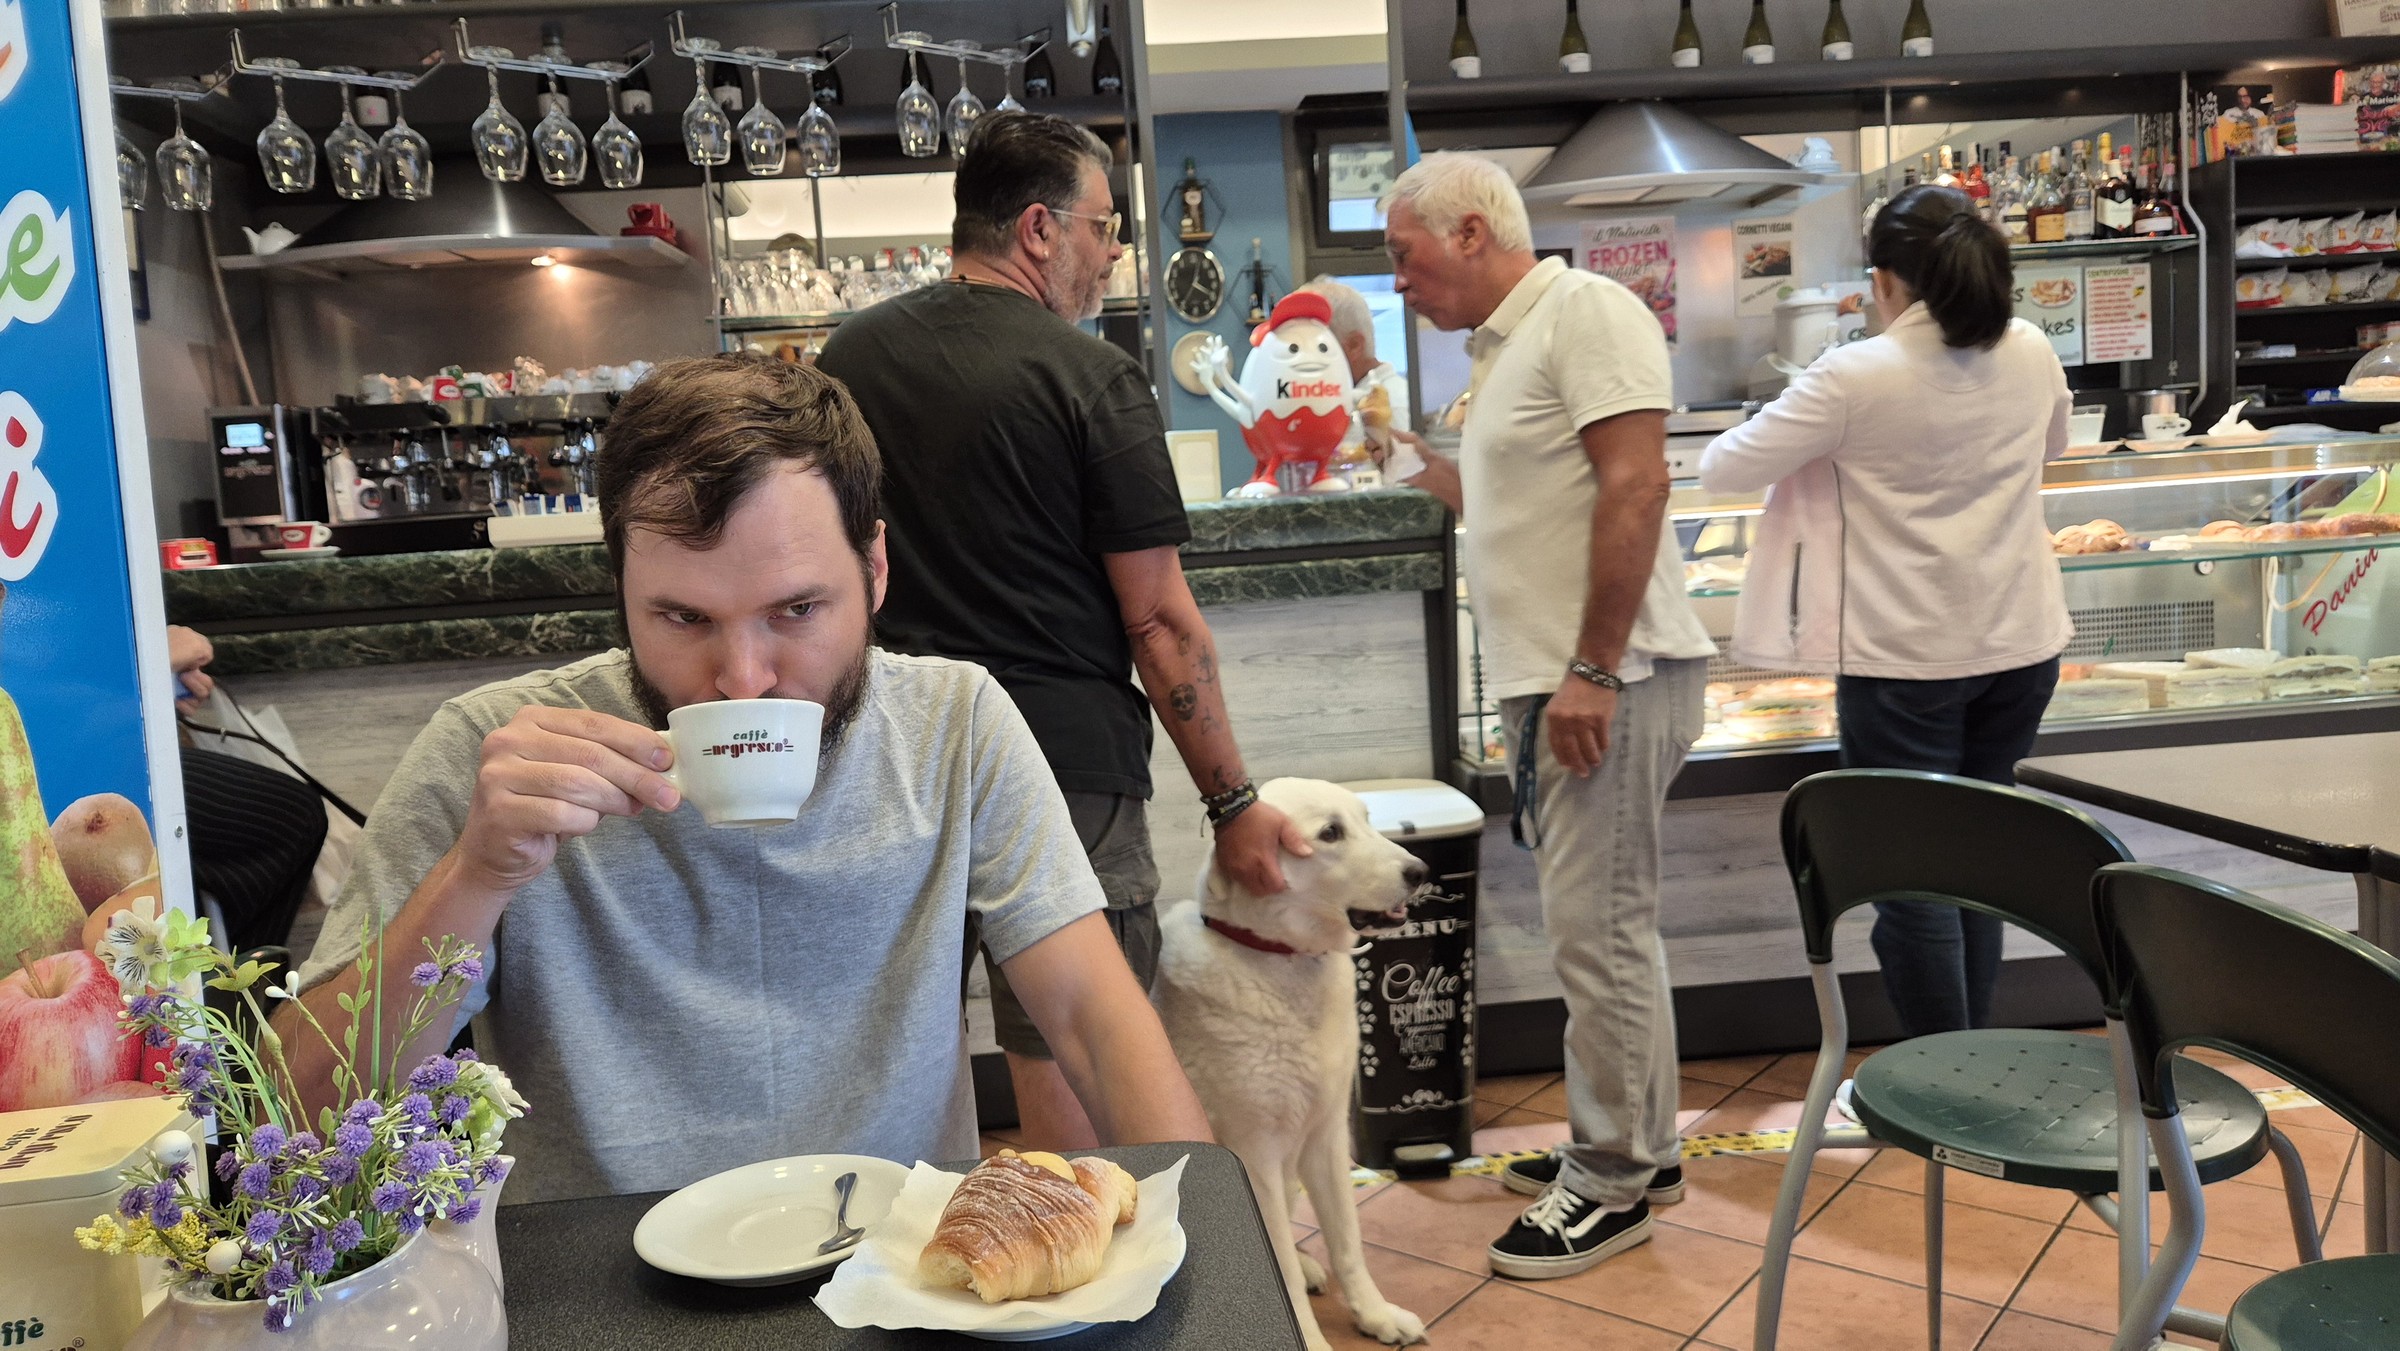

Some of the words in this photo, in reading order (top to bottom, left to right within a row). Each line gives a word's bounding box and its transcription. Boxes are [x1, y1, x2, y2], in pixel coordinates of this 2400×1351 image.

[1587, 240, 1669, 270] FROZEN
[2042, 317, 2076, 336] kes
[732, 729, 768, 741] caffè
[1381, 962, 1461, 1007] Coffee
[1389, 998, 1456, 1025] ESPRESSO
[1, 1316, 45, 1347] ffè
